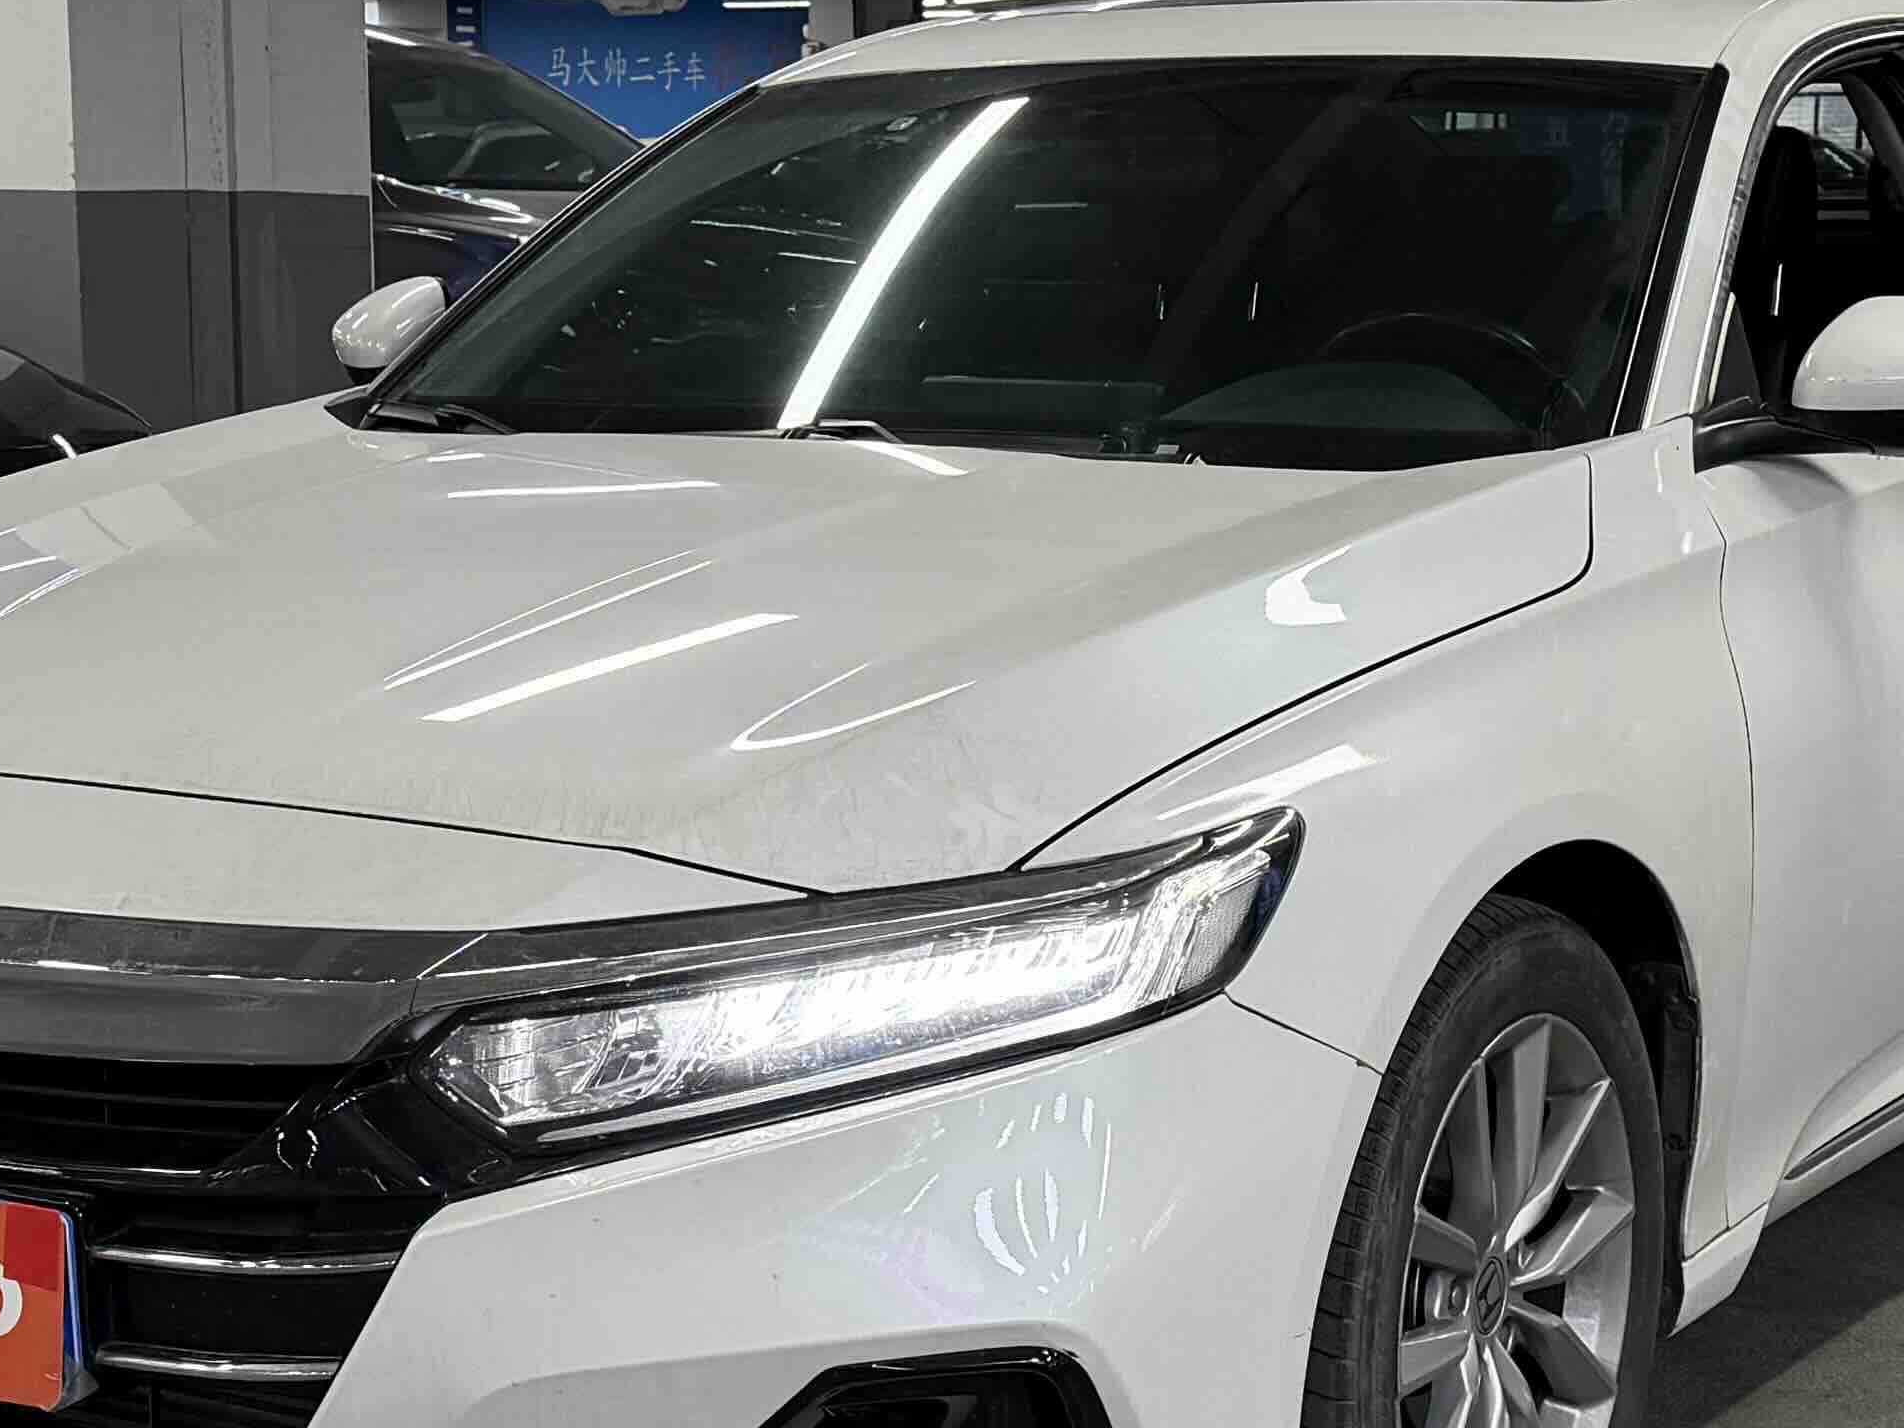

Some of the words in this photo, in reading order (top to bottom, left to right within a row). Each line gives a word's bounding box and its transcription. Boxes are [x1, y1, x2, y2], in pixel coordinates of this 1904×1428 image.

[548, 46, 706, 92] 马大帅二手车
